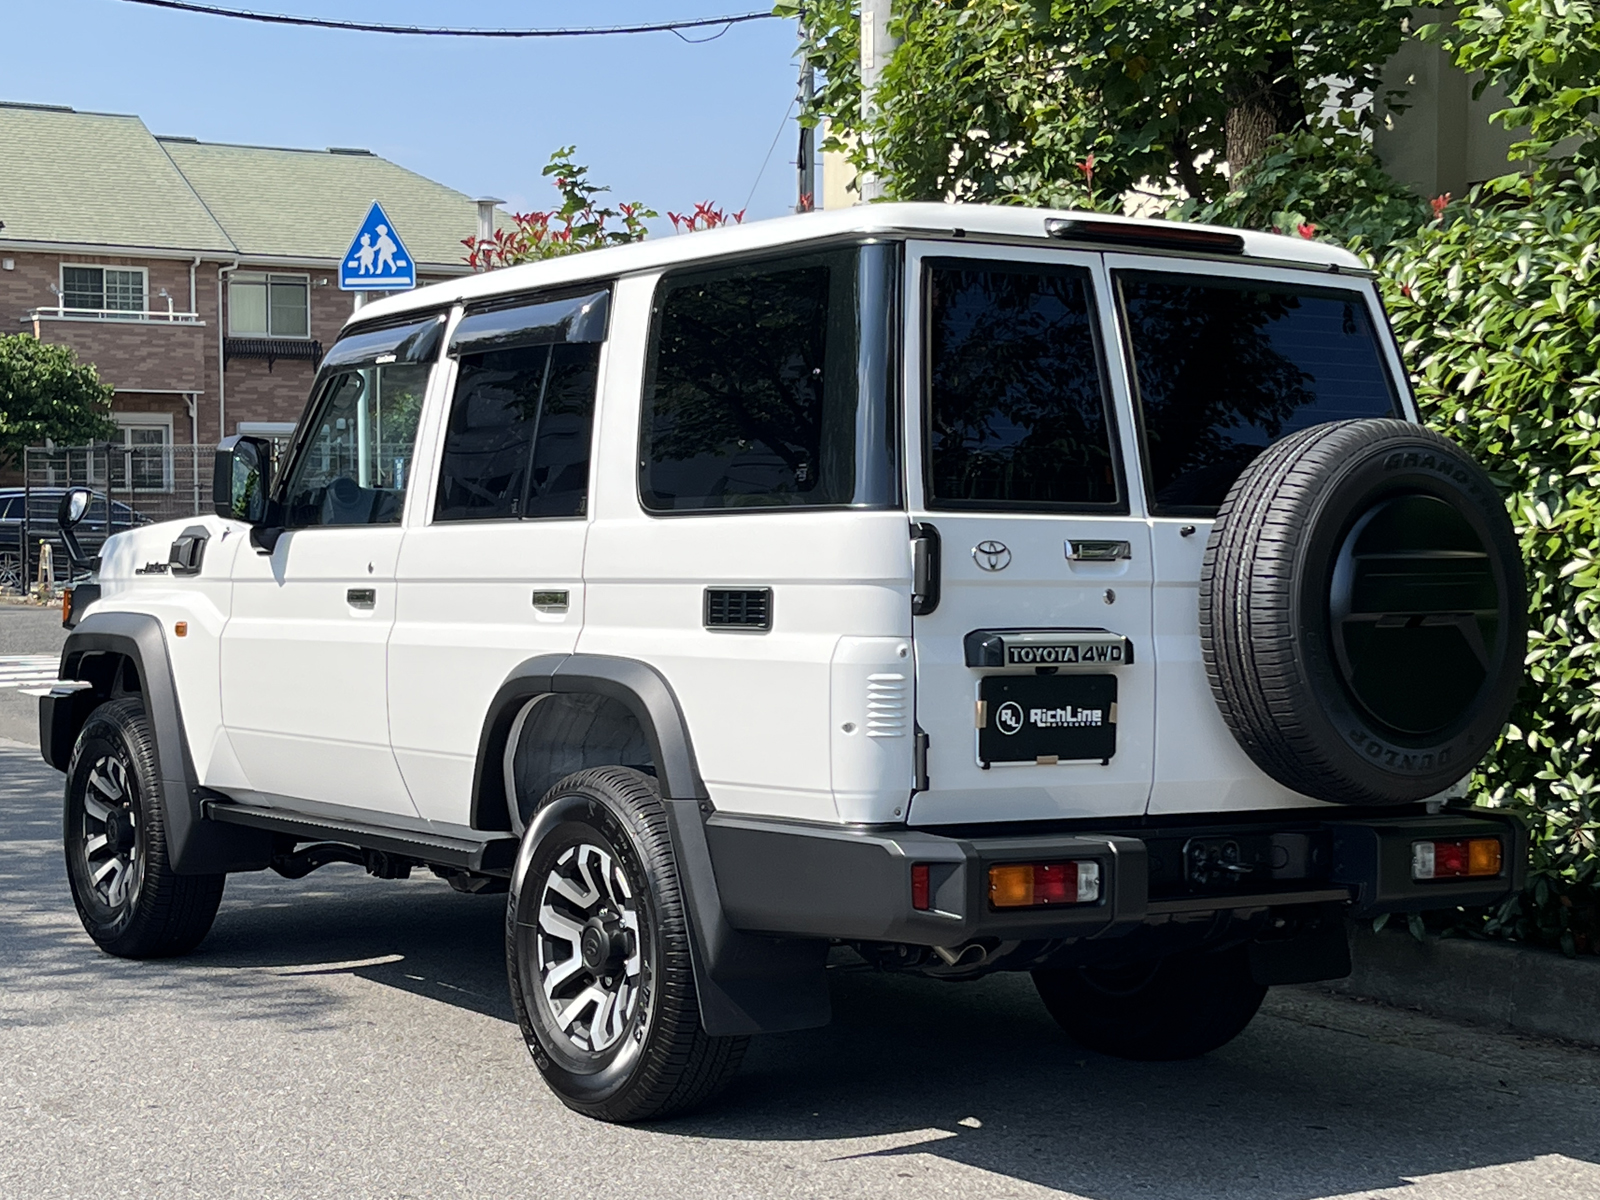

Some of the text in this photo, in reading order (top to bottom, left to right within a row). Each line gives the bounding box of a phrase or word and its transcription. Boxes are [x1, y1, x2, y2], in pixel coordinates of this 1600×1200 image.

[1010, 646, 1123, 663] TOYOTA 4WD
[1349, 730, 1451, 770] DUNLOP
